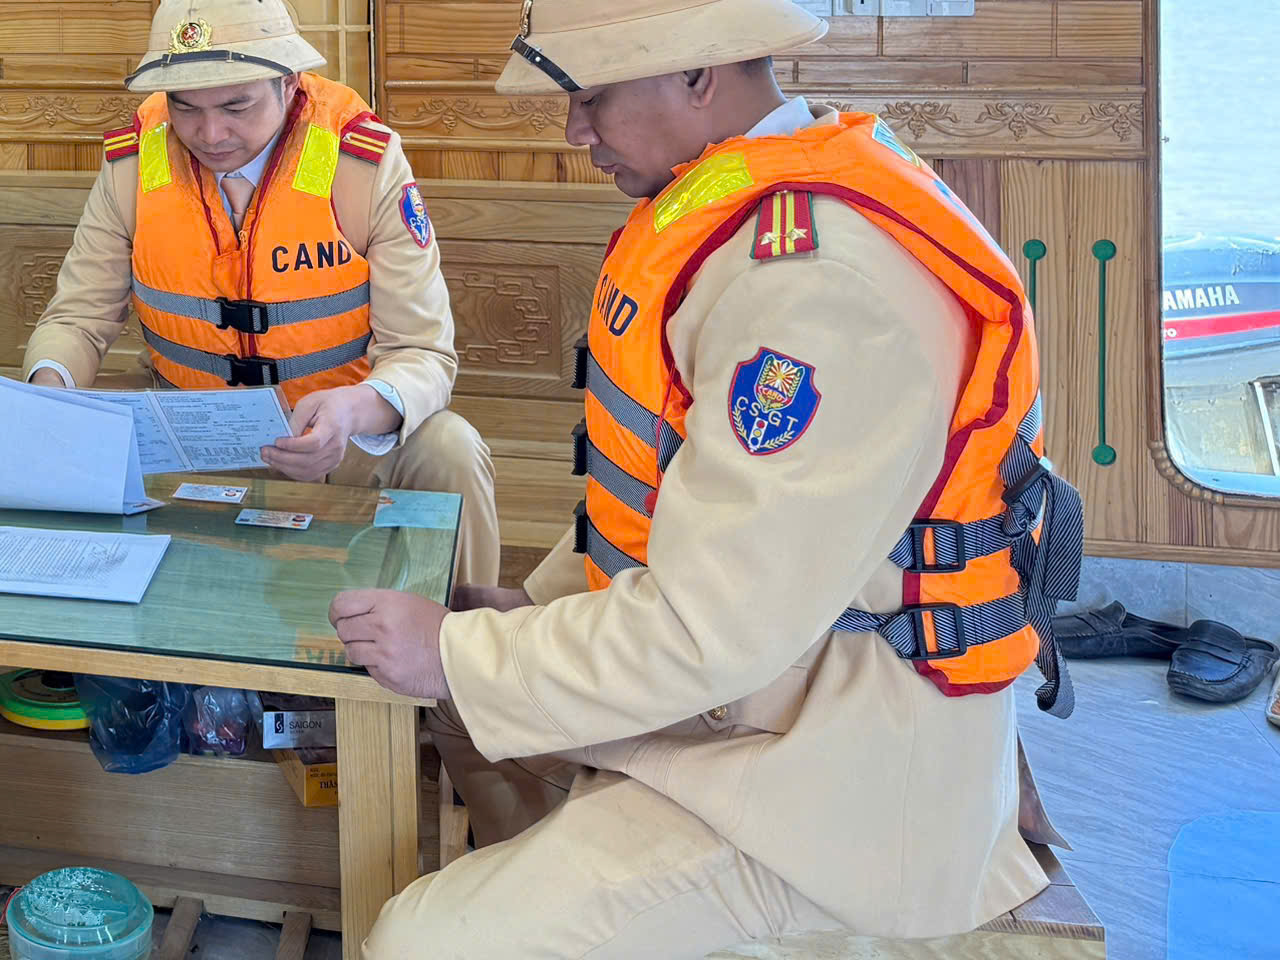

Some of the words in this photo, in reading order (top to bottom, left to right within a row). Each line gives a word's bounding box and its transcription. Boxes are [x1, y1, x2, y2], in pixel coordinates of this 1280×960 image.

[271, 239, 352, 273] CAND
[597, 273, 639, 337] CAND
[1163, 284, 1240, 310] AMAHA
[288, 720, 322, 730] SAIGON
